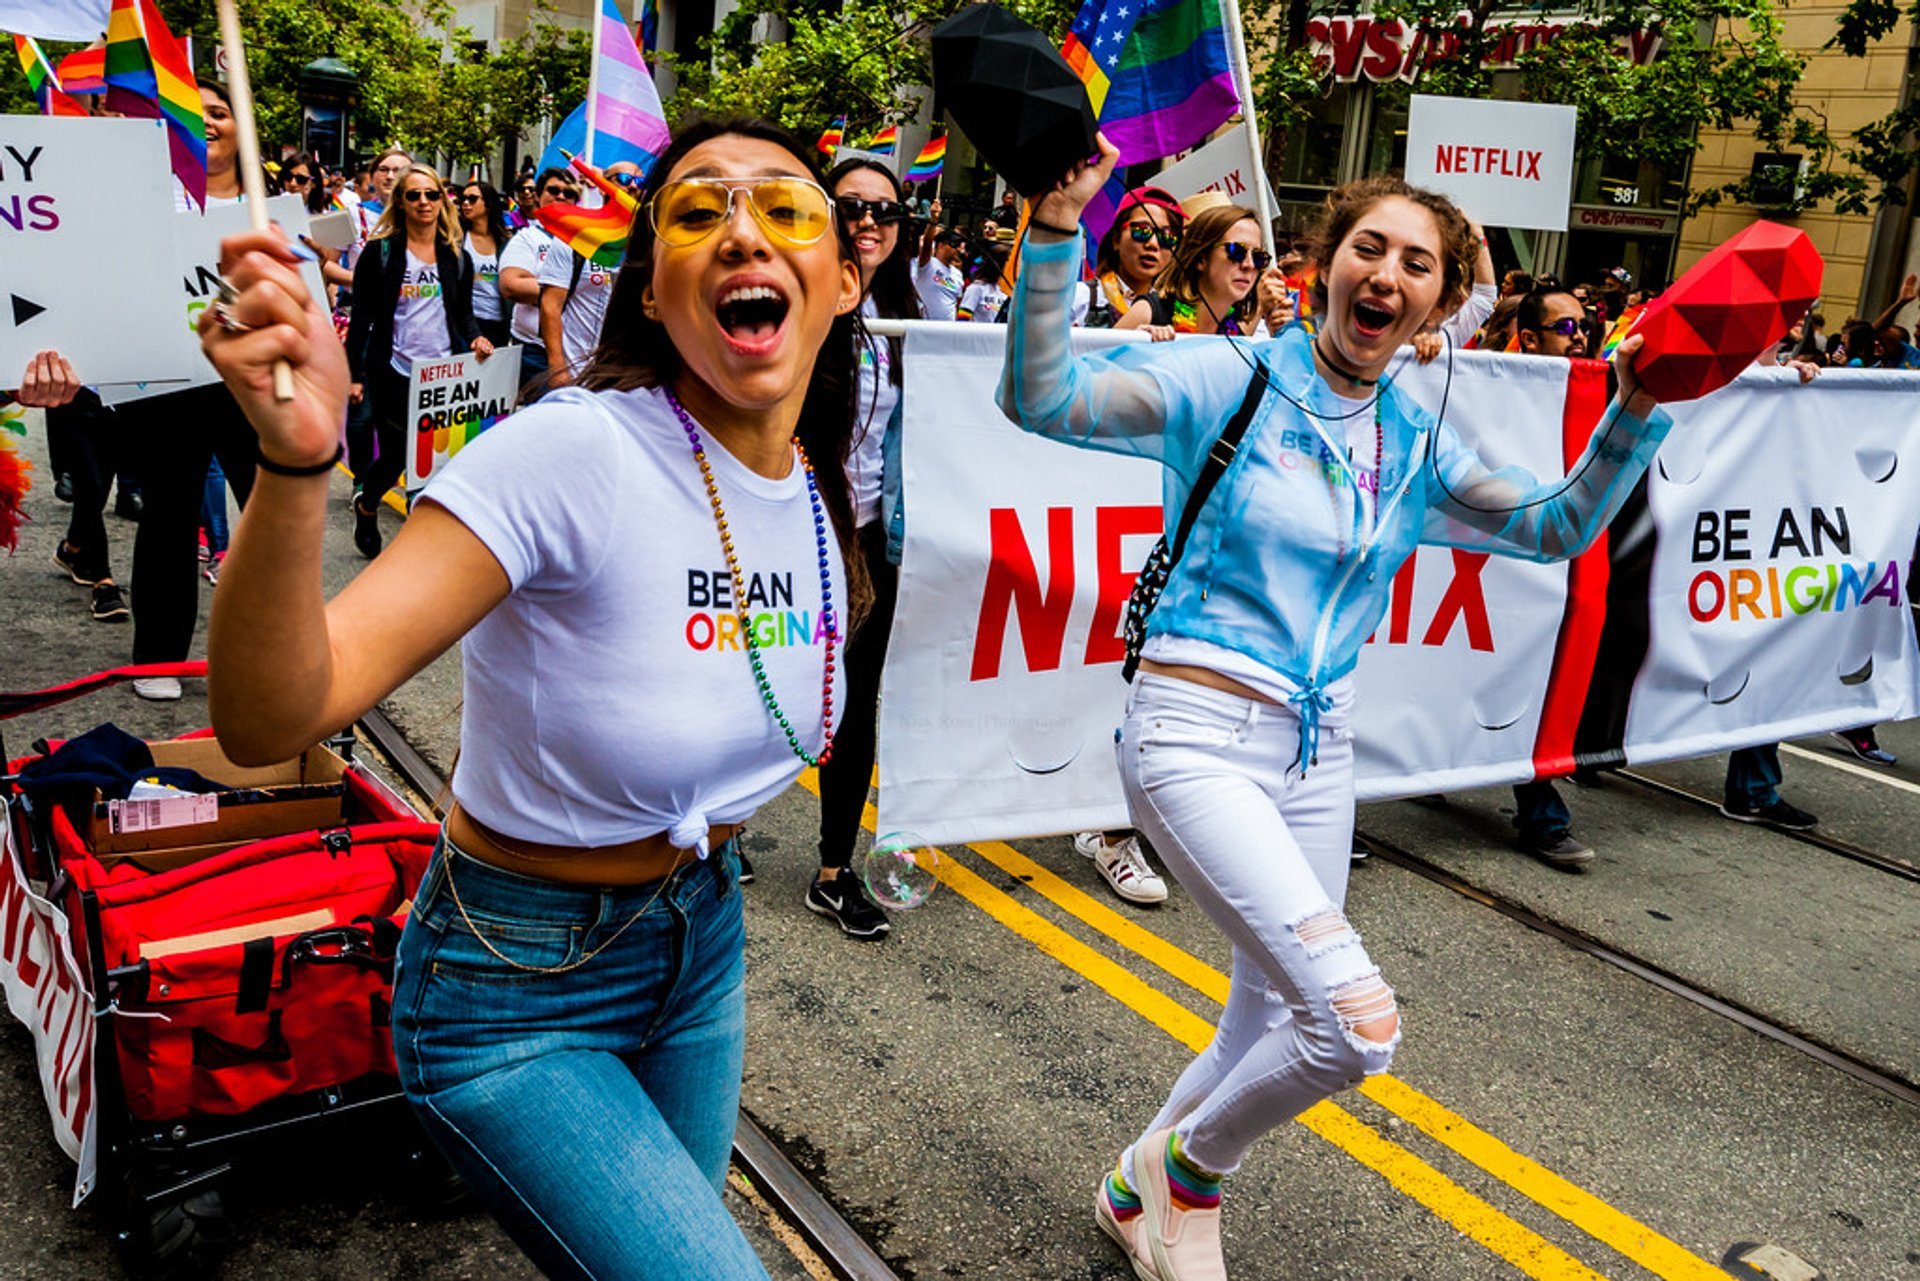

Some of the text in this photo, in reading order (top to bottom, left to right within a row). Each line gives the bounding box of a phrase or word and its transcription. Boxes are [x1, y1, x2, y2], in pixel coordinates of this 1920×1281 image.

[0, 145, 44, 182] Y
[1435, 144, 1543, 181] NETFLIX
[1613, 187, 1639, 204] 581
[420, 362, 464, 383] NETFLIX
[418, 380, 480, 409] BE AN
[418, 397, 510, 433] ORIGINAL
[1281, 429, 1312, 456] BE
[1691, 506, 1852, 563] BE AN
[687, 568, 793, 608] BE AN
[1688, 560, 1908, 623] ORIGINA
